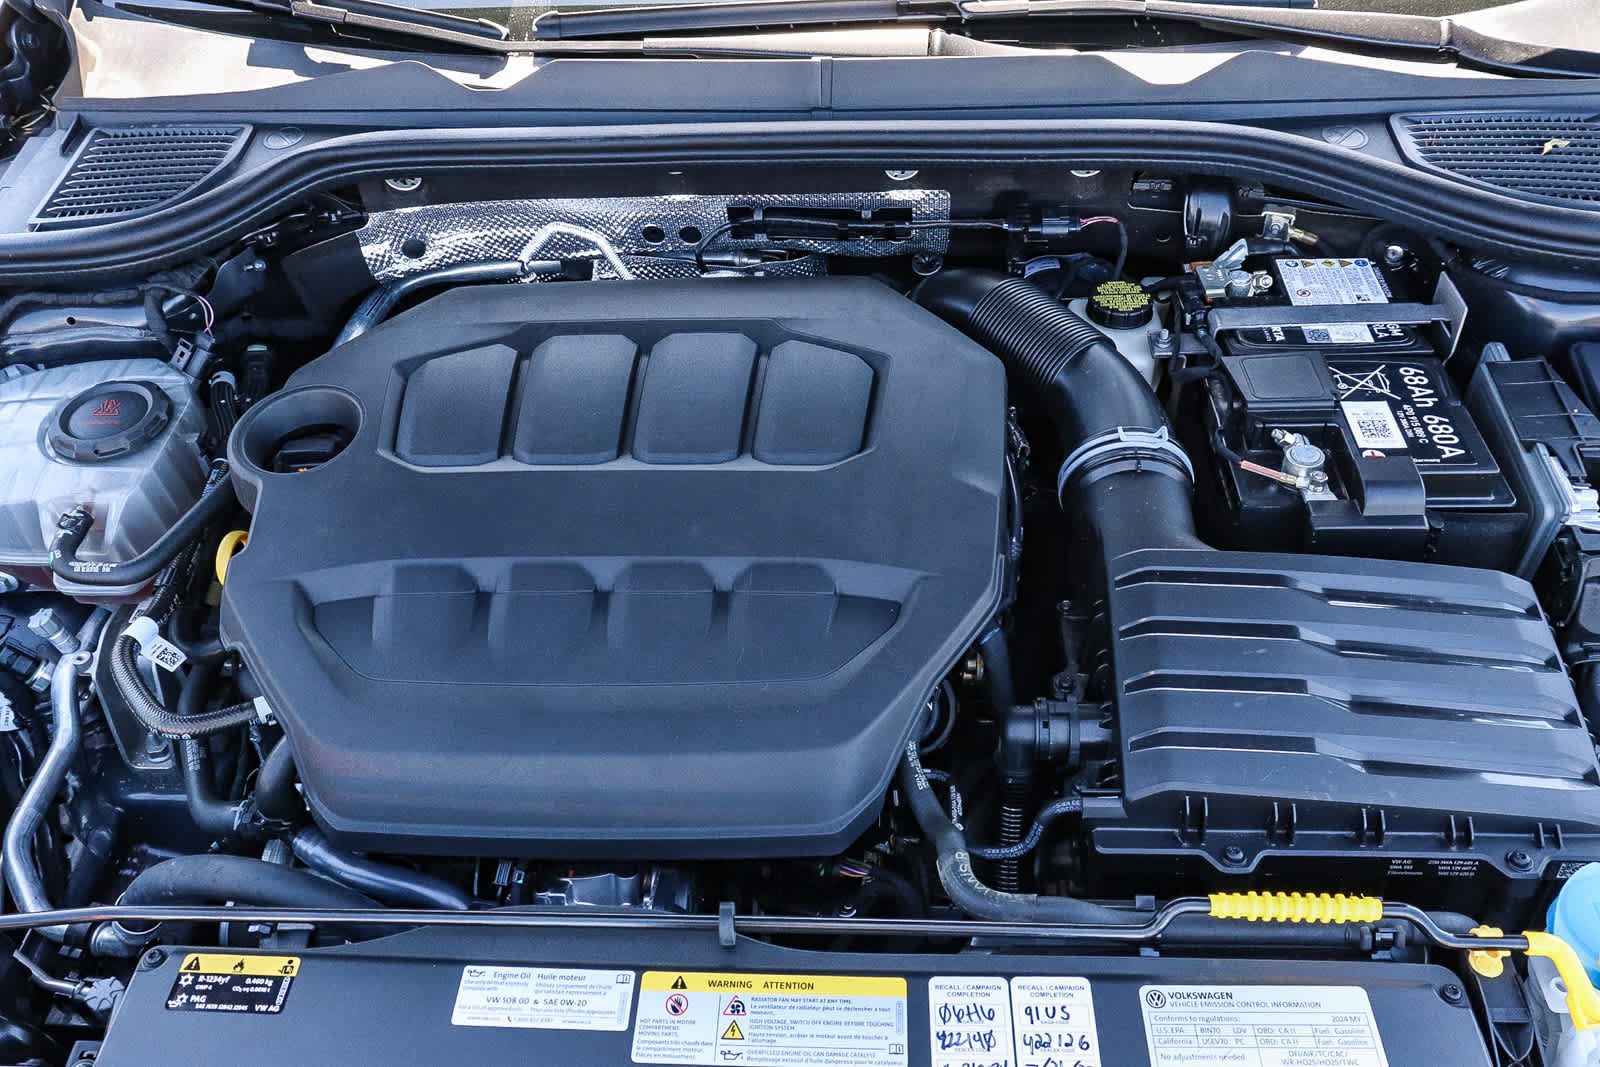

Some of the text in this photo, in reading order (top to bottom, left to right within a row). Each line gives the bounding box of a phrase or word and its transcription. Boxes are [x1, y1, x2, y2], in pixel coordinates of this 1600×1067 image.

[1387, 324, 1404, 336] GM
[1400, 366, 1439, 408] 68Ah
[1424, 414, 1466, 459] 680A
[198, 975, 231, 985] R-1234yf
[265, 979, 274, 987] kg
[493, 971, 518, 980] Engine
[520, 972, 531, 980] Oil
[537, 973, 556, 981] Huile
[708, 980, 814, 990] WARNING ATTENTION
[190, 995, 207, 1003] PAG
[1335, 1027, 1365, 1035] Gasoline
